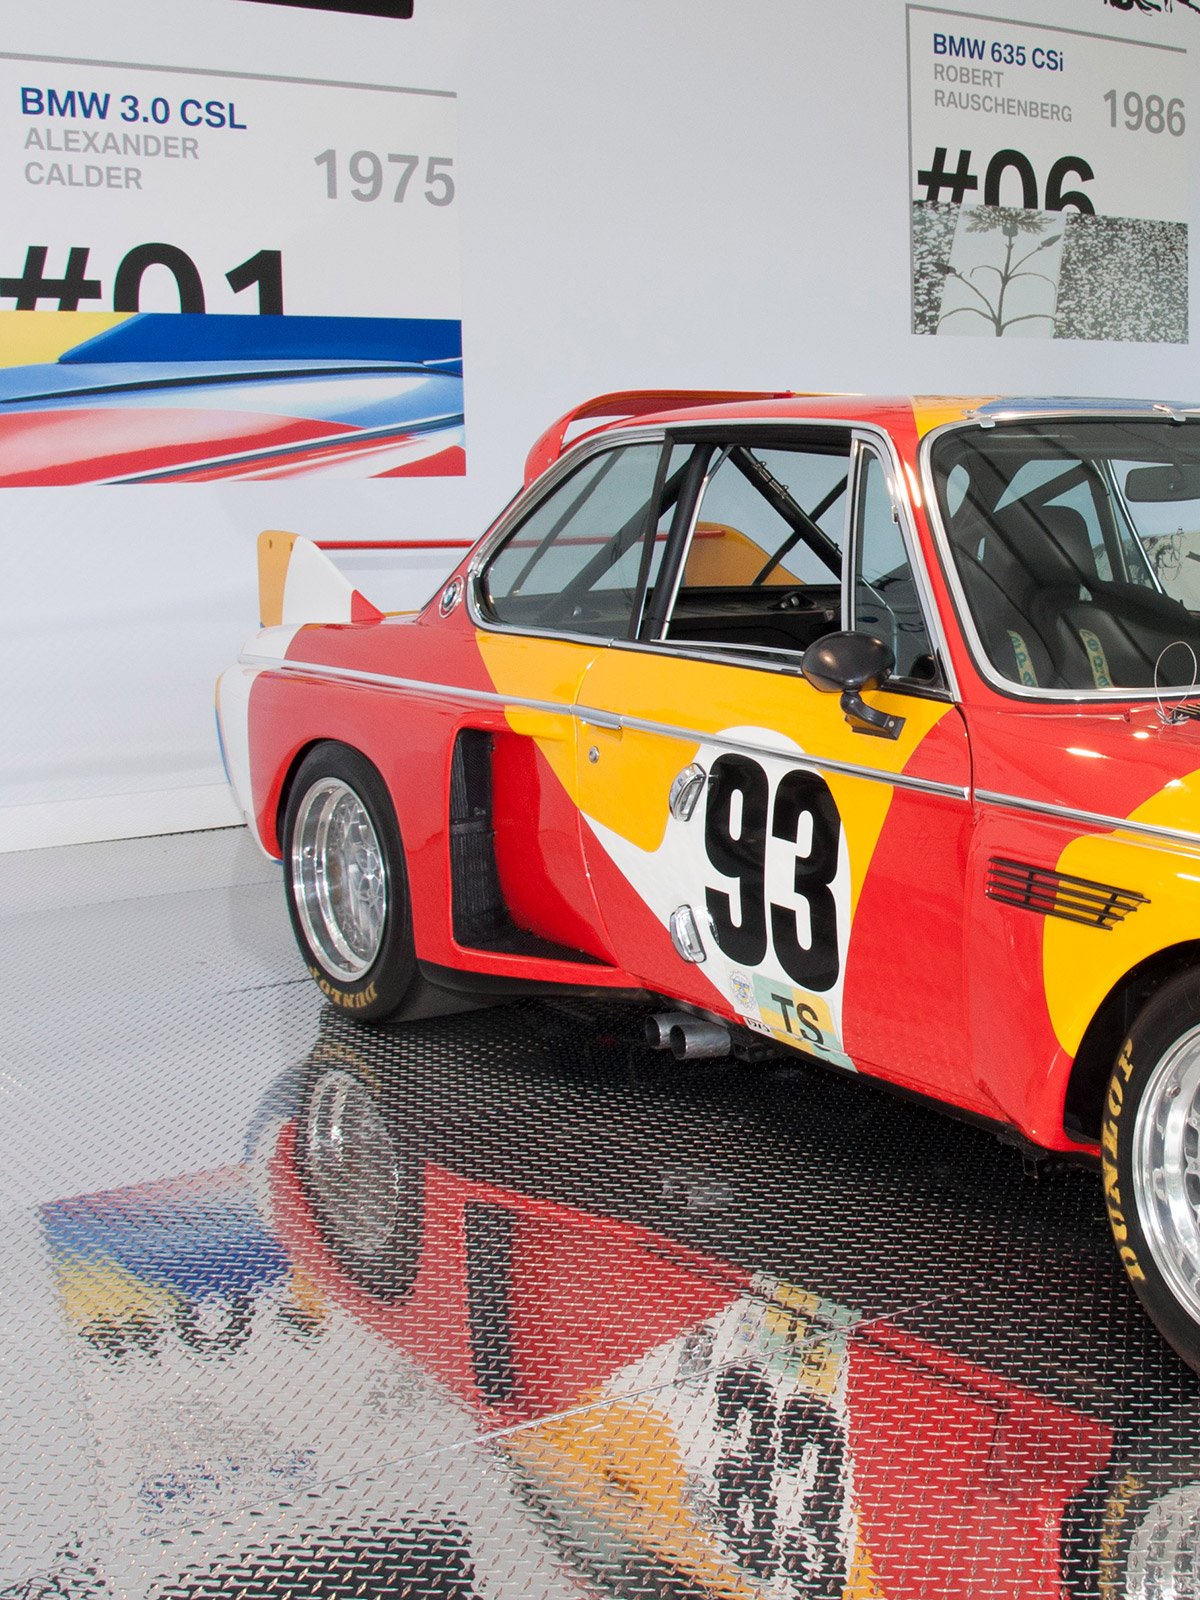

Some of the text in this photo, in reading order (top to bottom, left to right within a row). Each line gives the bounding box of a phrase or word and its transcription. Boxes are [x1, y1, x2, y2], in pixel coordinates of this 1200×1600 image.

[933, 33, 1064, 72] BMW 635 CSi
[934, 63, 1004, 89] ROBERT
[20, 87, 247, 130] BMW 3.0 CSL
[934, 89, 1073, 123] RAUSCHENBERG
[1103, 88, 1186, 137] 1986
[24, 127, 200, 160] ALEXANDER
[24, 161, 143, 190] CALDER
[314, 148, 456, 207] 1975
[917, 147, 1096, 216] #06
[704, 753, 841, 992] 93
[771, 992, 831, 1052] TS
[1102, 1038, 1147, 1282] DUNLOP
